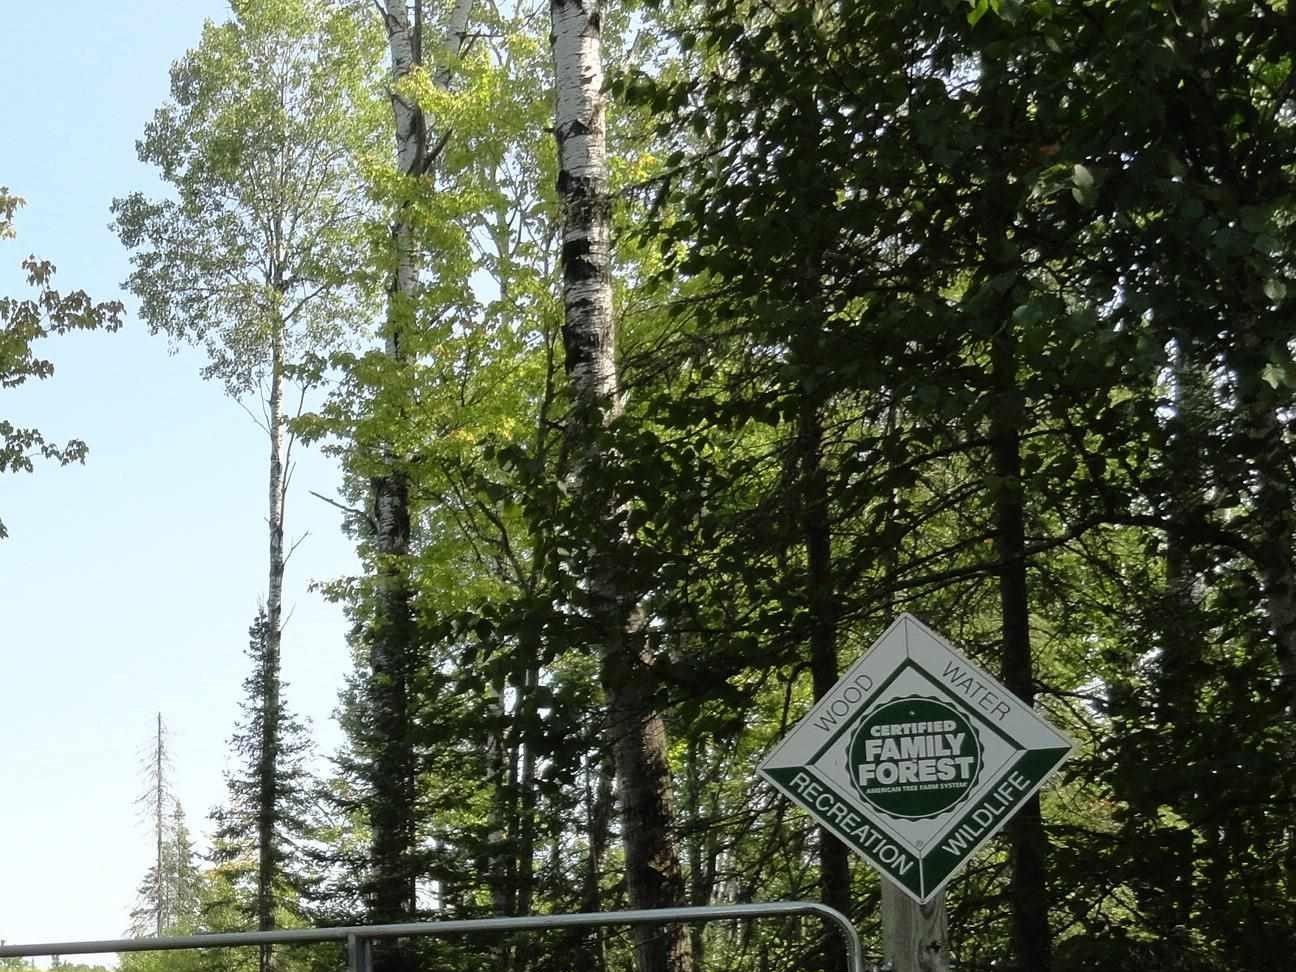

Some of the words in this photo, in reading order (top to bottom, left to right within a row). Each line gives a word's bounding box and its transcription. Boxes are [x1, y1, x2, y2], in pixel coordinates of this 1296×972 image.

[813, 674, 874, 733] WOOD
[942, 661, 1010, 721] WATER
[865, 732, 966, 762] FAMILY
[870, 720, 957, 737] CERTIFIED
[858, 756, 974, 787] FOREST
[788, 771, 914, 876] RECREATION
[941, 770, 1032, 857] WILDLIFE
